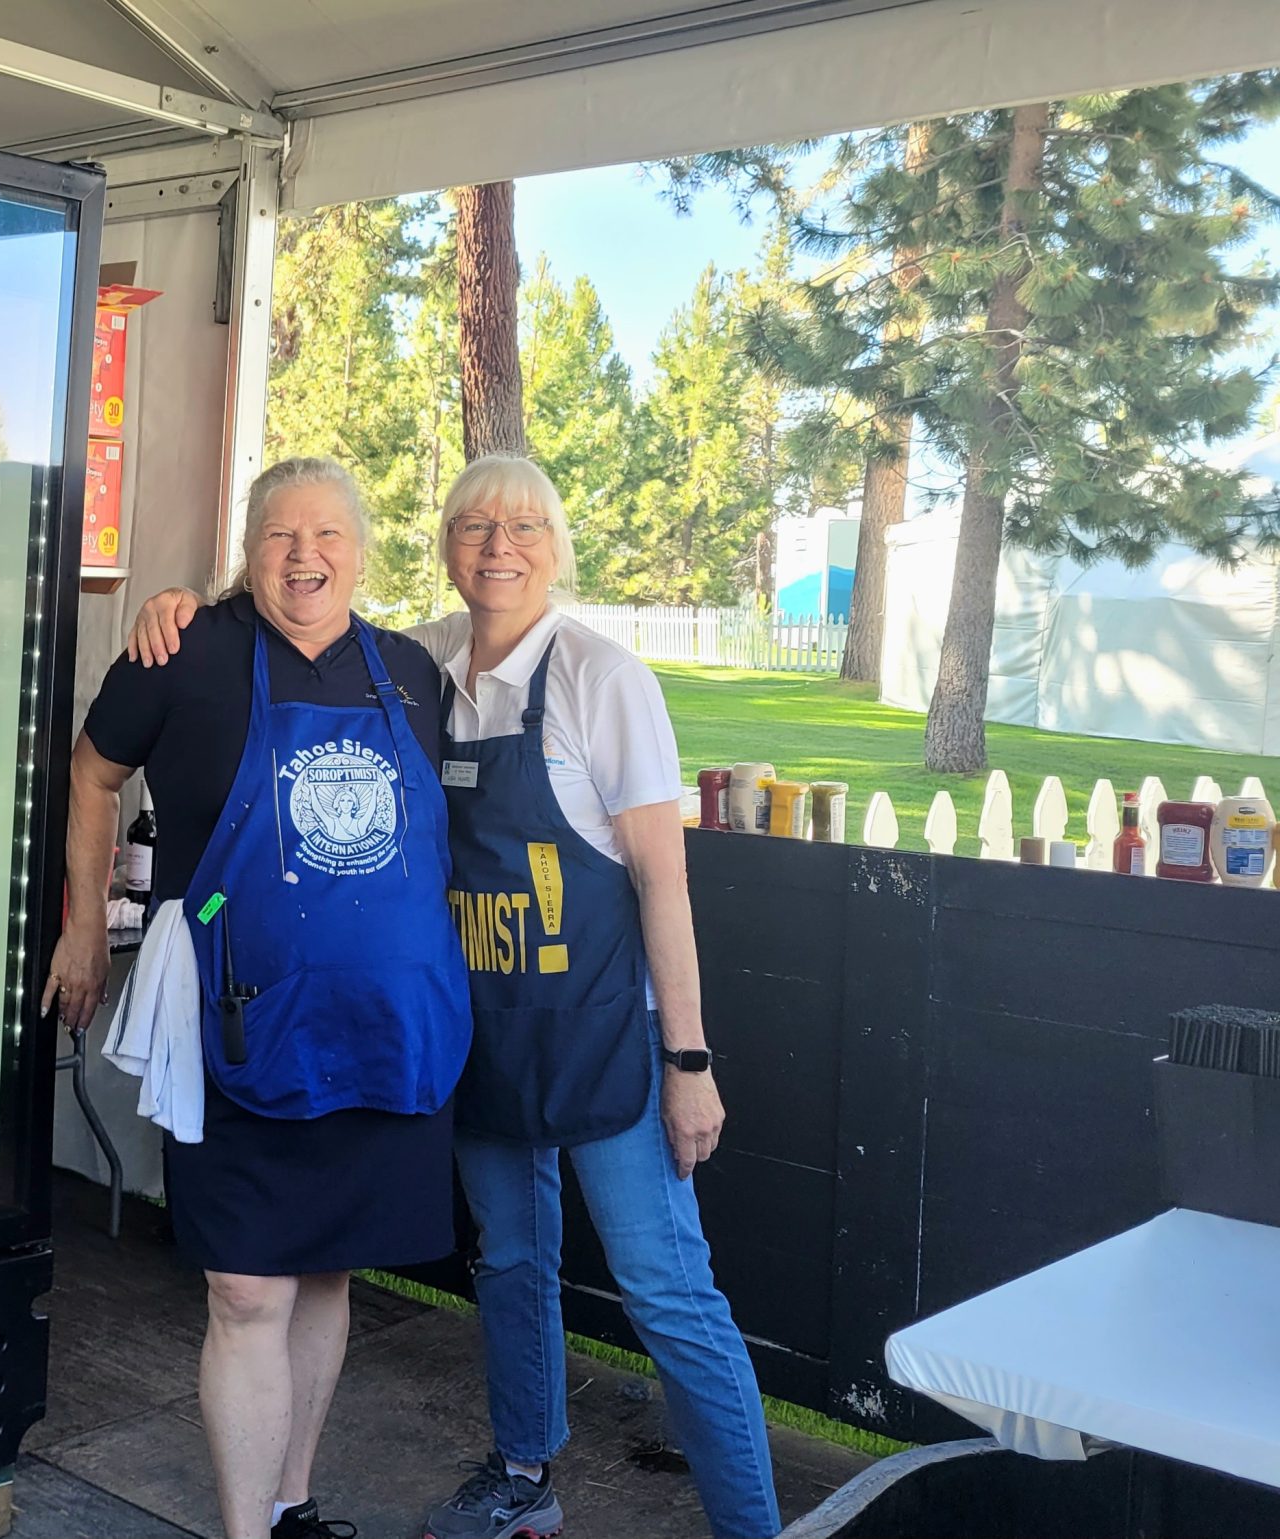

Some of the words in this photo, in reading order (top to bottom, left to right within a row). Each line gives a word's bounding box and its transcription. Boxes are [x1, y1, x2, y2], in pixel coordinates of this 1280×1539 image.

[108, 403, 119, 417] 30
[103, 533, 114, 546] 30
[279, 741, 337, 780] Tahoe
[342, 739, 398, 782] Sierra
[308, 768, 378, 782] SOROPTIMIST
[1172, 826, 1192, 835] HEINZ
[310, 831, 386, 855] INTERNATIONAL
[539, 847, 551, 881] TAHOE
[328, 867, 336, 875] &
[336, 868, 358, 876] youth
[545, 886, 555, 928] SIERRA
